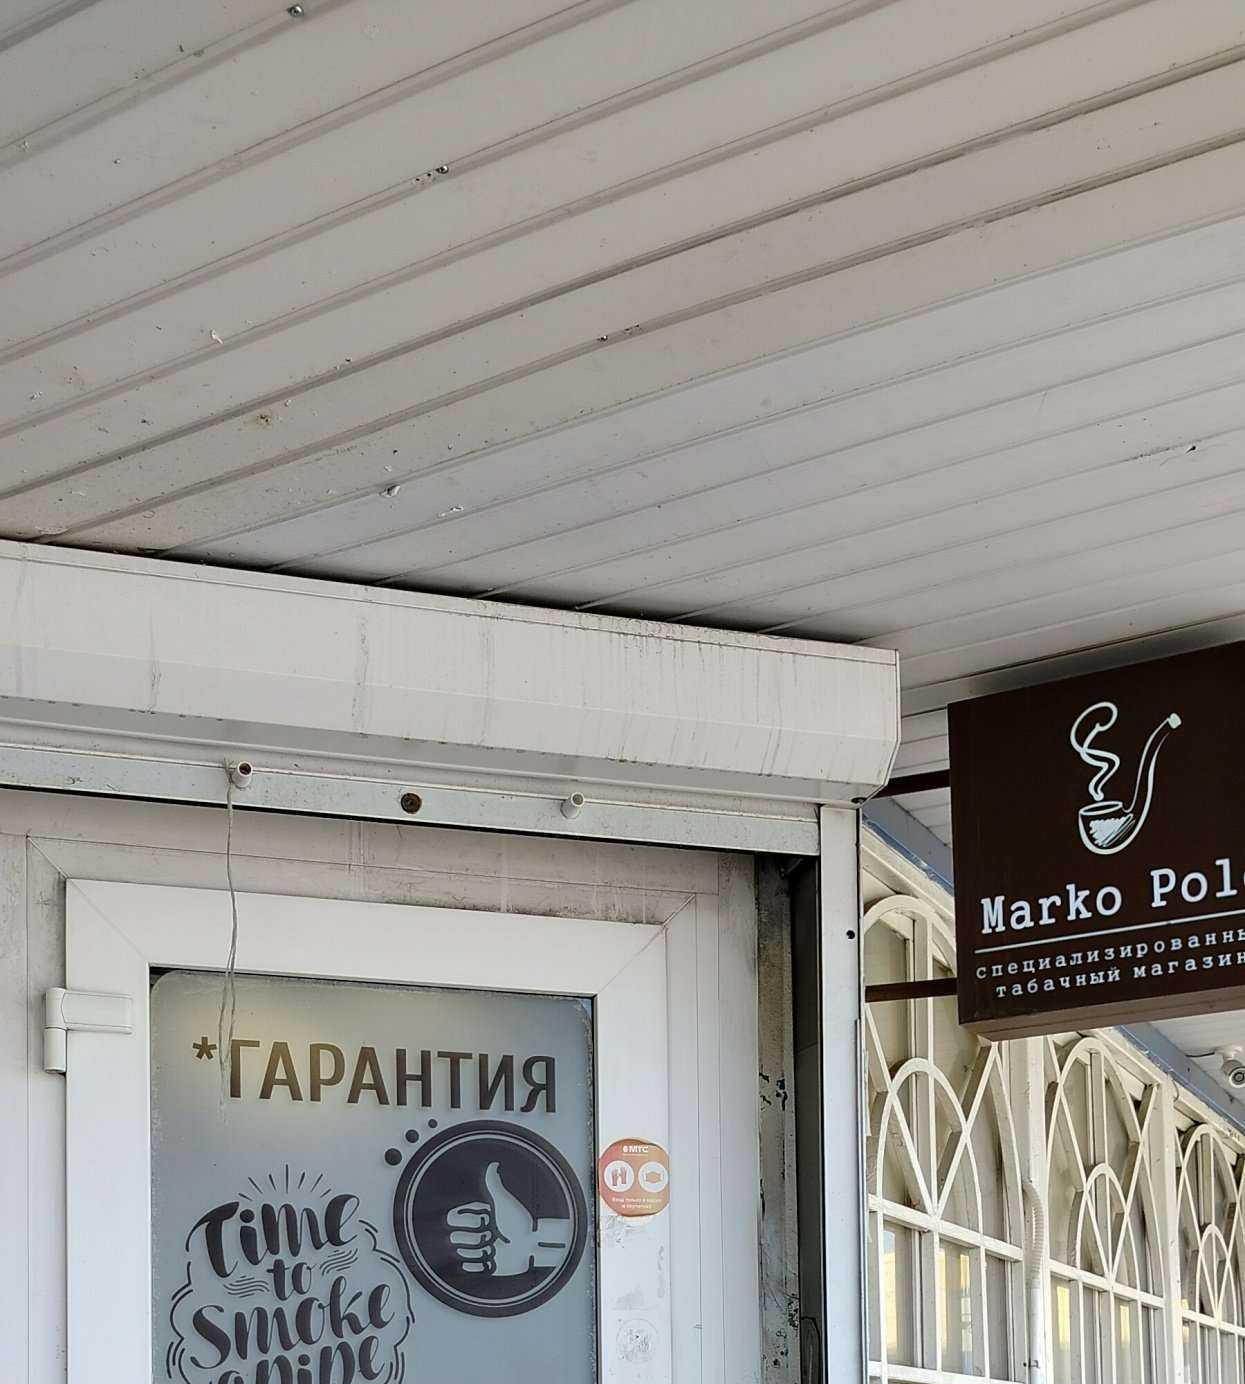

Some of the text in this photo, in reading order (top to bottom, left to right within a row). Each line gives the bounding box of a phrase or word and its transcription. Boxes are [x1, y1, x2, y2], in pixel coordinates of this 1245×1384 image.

[981, 858, 1245, 935] Marko Pol
[996, 951, 1245, 998] табачный магазин
[189, 1194, 360, 1278] Time
[267, 1258, 314, 1301] to
